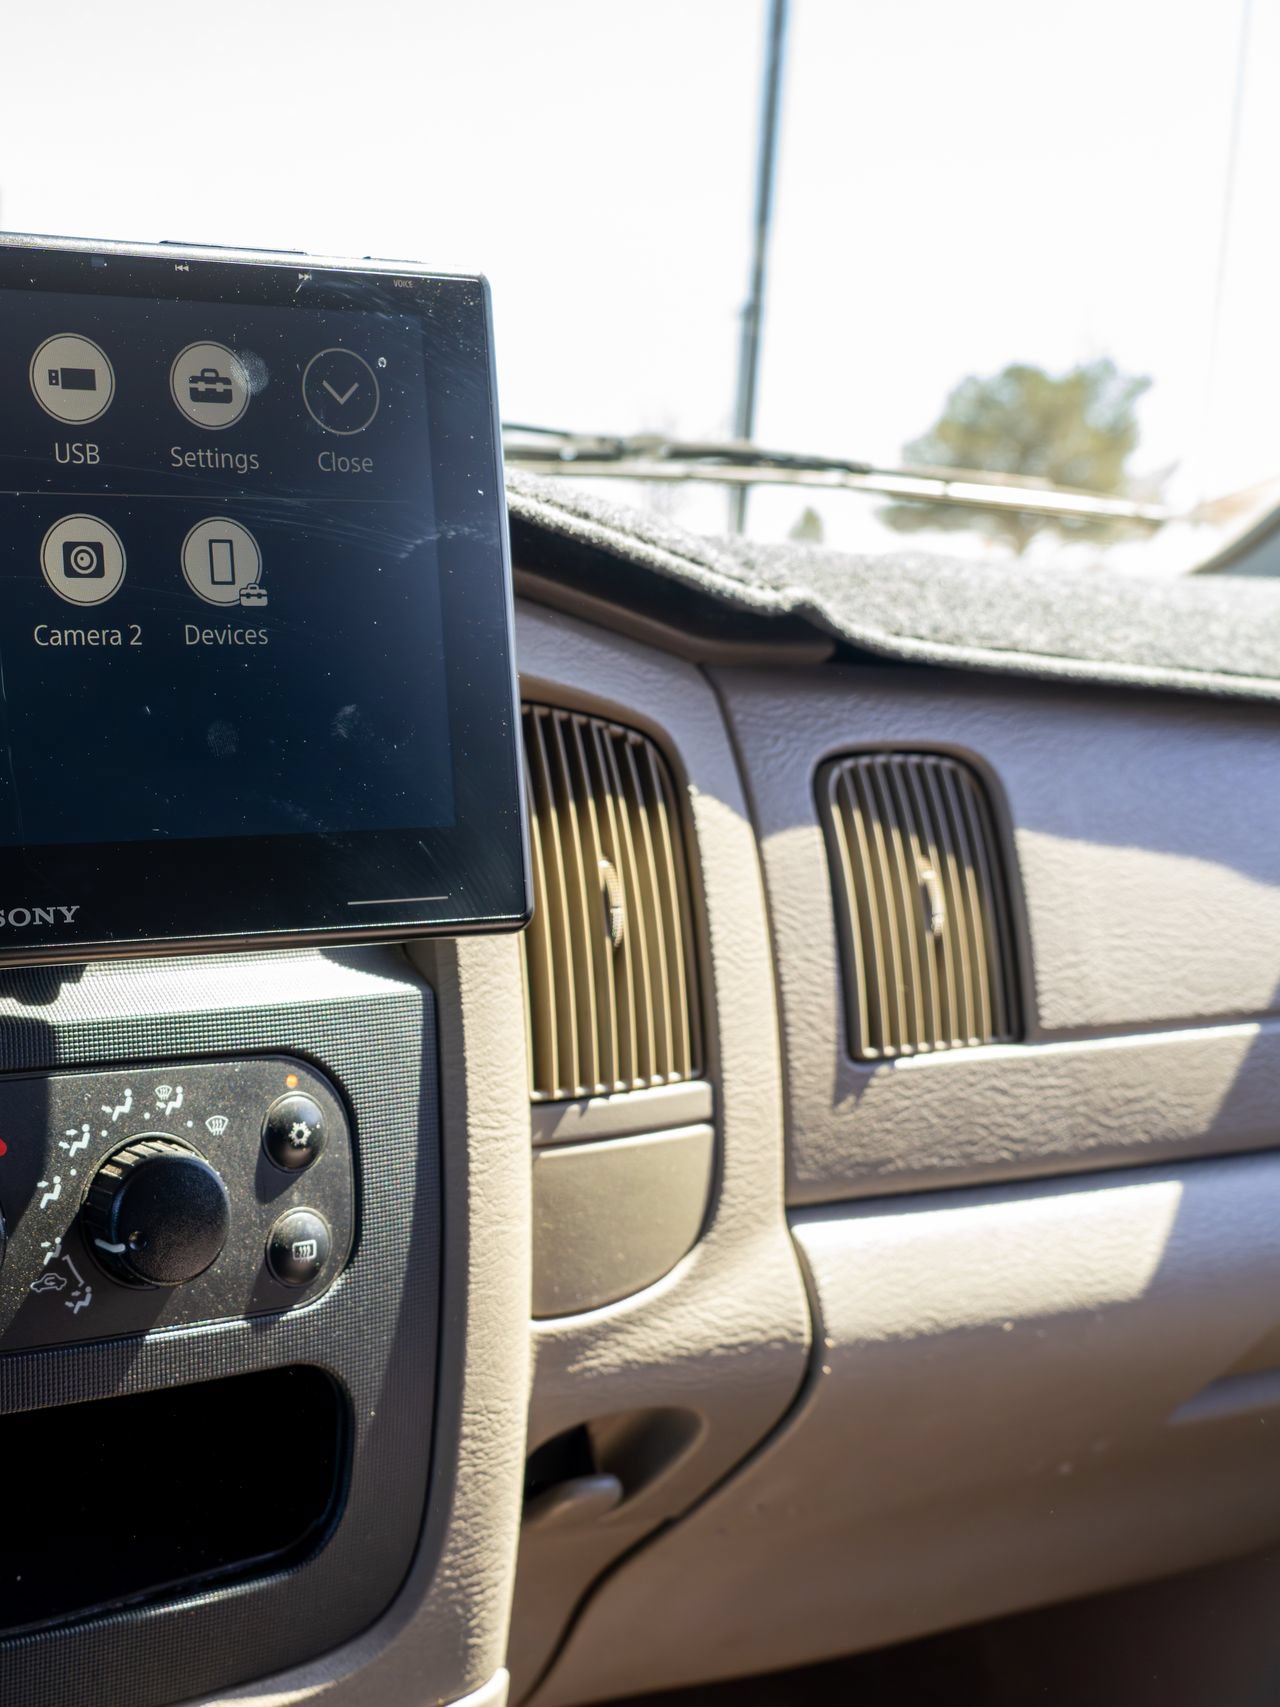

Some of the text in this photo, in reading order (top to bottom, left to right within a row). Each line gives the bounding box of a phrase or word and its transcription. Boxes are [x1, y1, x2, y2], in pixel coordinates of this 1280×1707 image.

[393, 279, 414, 289] VOICE
[55, 442, 100, 465] USB
[170, 446, 260, 473] Settings
[318, 451, 374, 473] Close
[34, 625, 143, 646] Camera 2
[185, 625, 269, 646] Devices
